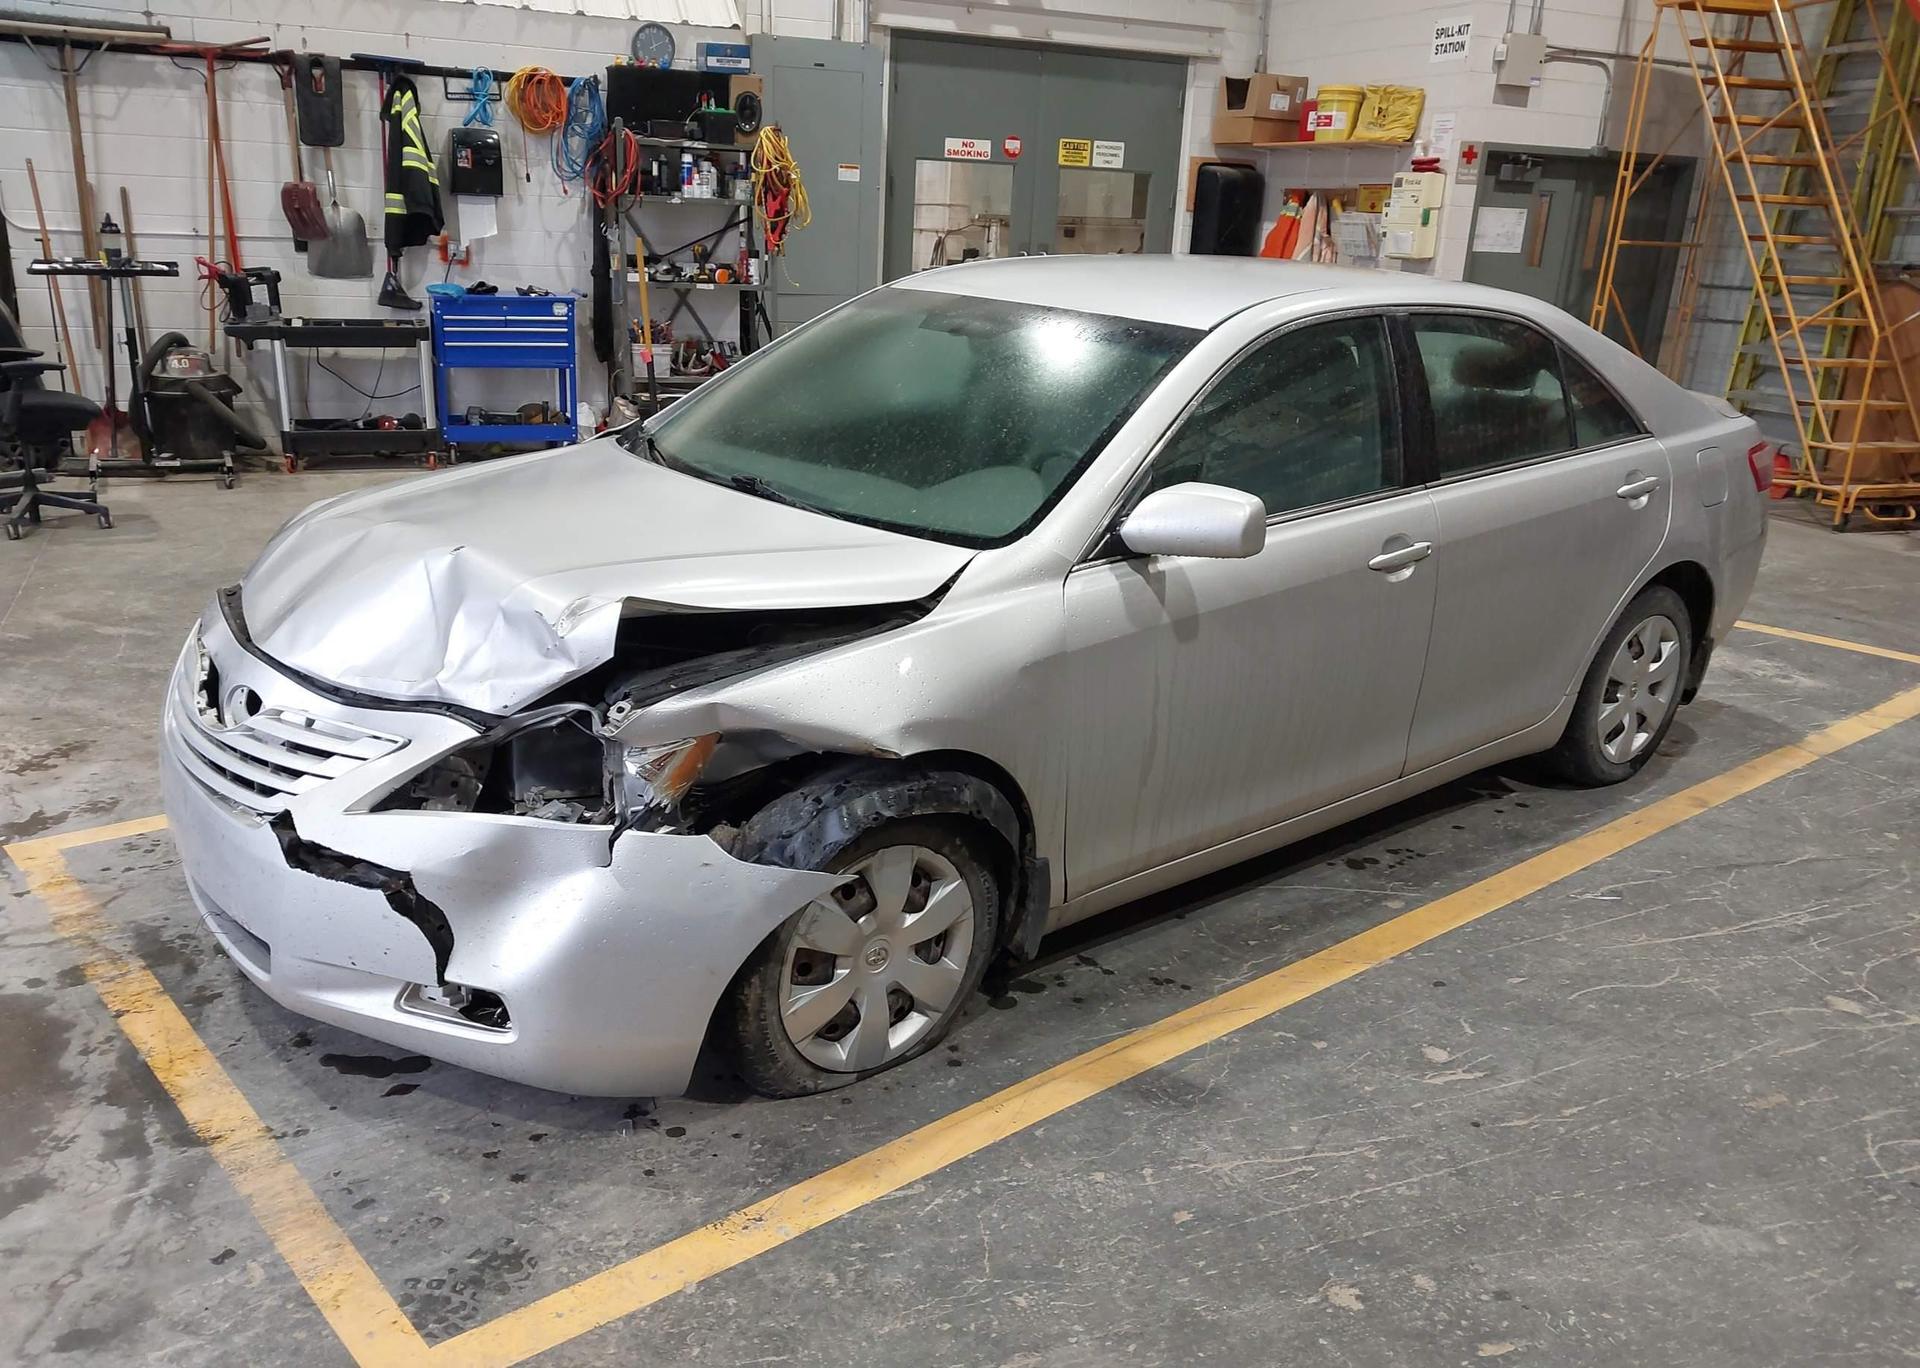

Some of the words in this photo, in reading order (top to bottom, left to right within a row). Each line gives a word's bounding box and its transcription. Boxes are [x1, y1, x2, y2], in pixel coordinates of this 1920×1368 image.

[1435, 24, 1471, 39] SPILL-KIT
[1435, 40, 1466, 55] STATION
[1062, 142, 1089, 151] CAUTION
[946, 149, 989, 159] SMOKING
